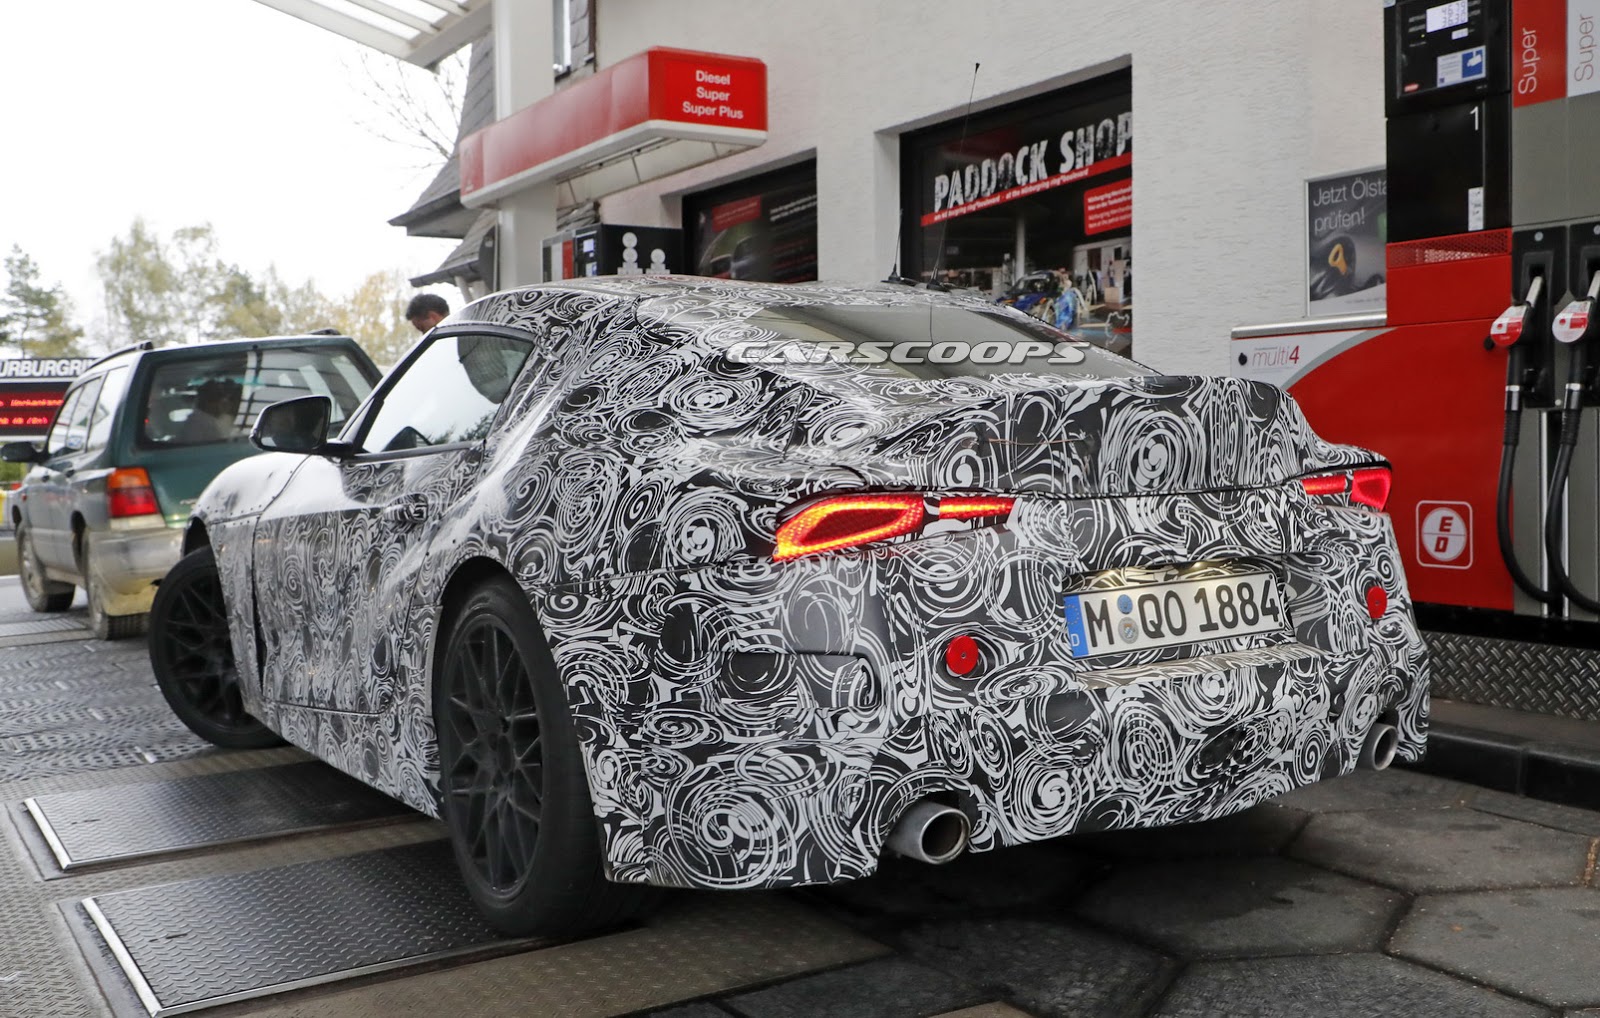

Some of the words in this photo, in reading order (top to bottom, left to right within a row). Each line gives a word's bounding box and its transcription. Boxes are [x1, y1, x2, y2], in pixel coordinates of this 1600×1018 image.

[1574, 13, 1597, 82] Super
[1518, 28, 1540, 95] Super
[696, 70, 730, 85] Diesel
[696, 86, 731, 101] Super
[682, 101, 717, 116] Super
[719, 105, 744, 119] Plus
[1470, 105, 1479, 131] 1
[933, 139, 1048, 213] PADDOCK
[1059, 111, 1132, 174] SHOP
[1313, 185, 1347, 207] Jetzt
[1315, 206, 1365, 235] prüfen!
[1252, 345, 1300, 366] multi4
[1439, 516, 1454, 532] E
[1084, 598, 1115, 647] M
[1137, 590, 1187, 639] QO
[1194, 579, 1279, 633] 1884
[1071, 633, 1080, 647] D
